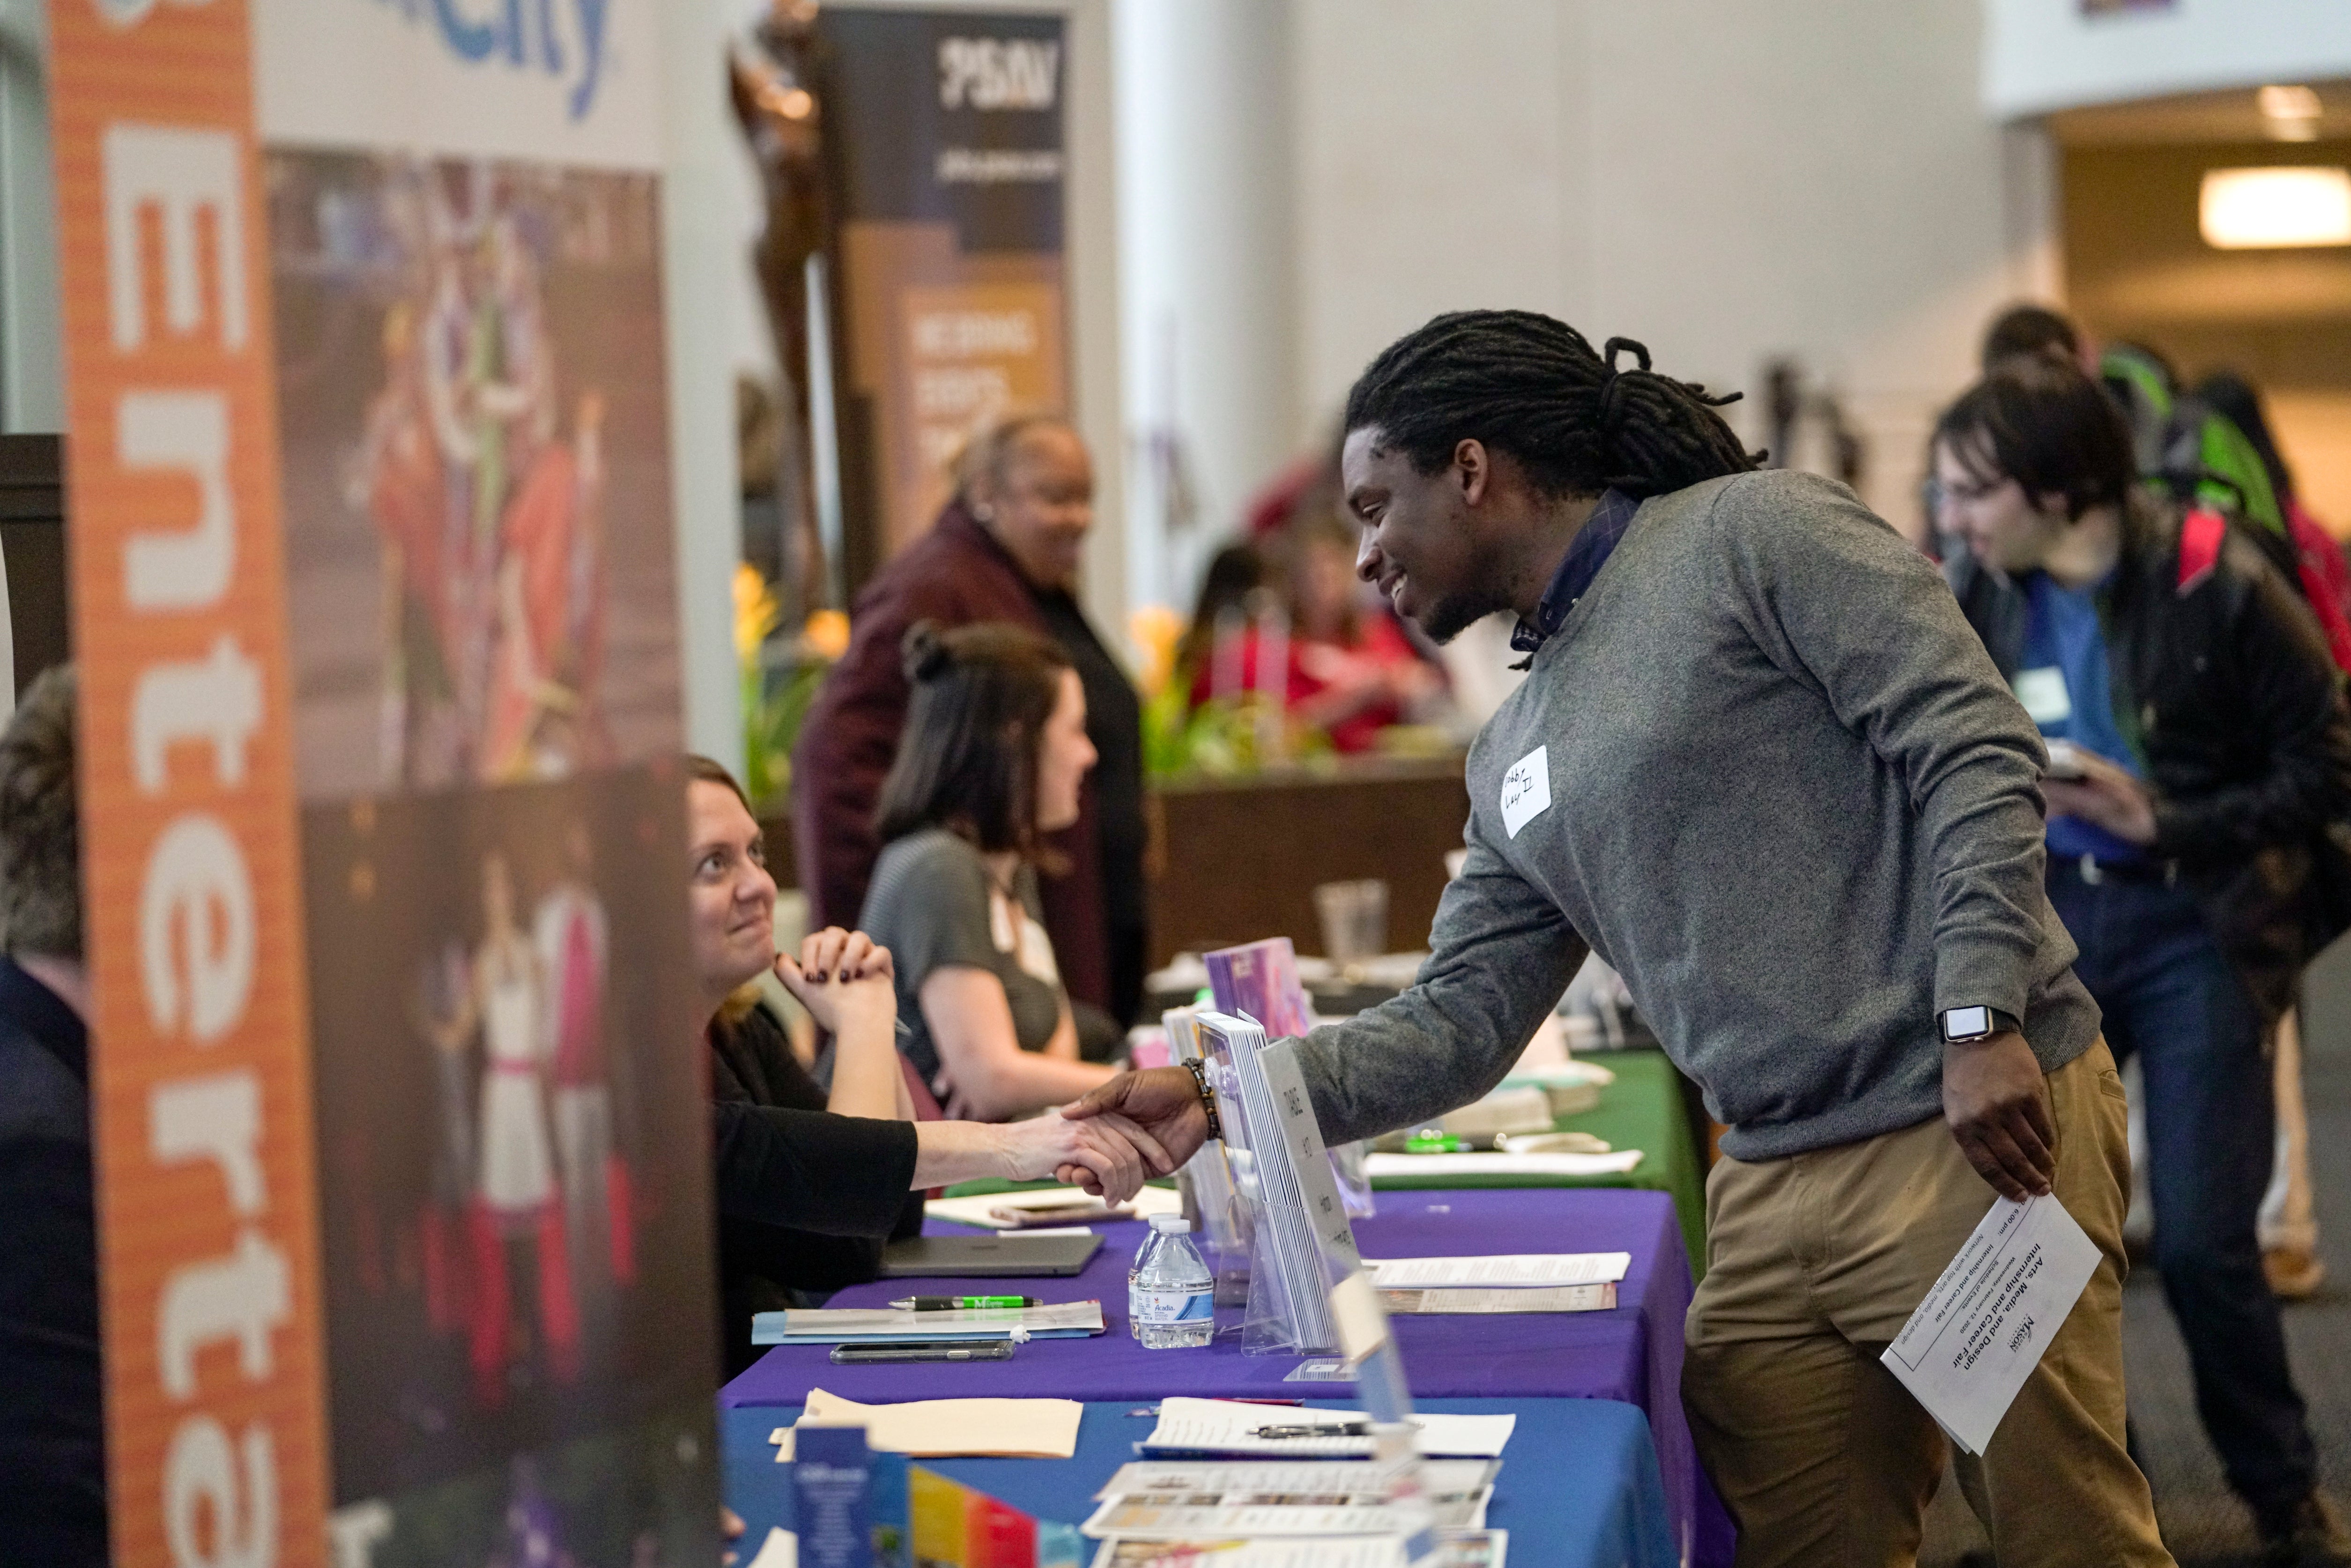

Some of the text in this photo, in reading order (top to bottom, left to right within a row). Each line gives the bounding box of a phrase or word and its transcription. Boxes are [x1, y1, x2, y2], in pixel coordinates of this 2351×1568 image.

[2007, 1209, 2019, 1224] 6:00
[1998, 1222, 2008, 1236] pm:
[1964, 1234, 1984, 1258] Network
[1954, 1258, 1965, 1271] with
[1980, 1260, 1999, 1285] Schedule
[1992, 1257, 2016, 1287] Wednesday,
[1935, 1244, 1994, 1323] Internship and Career Fair
[1947, 1271, 1956, 1281] top
[1936, 1281, 1947, 1294] arts,
[1923, 1294, 1938, 1313] media,
[1953, 1243, 2041, 1368] Internship and Career Fair
[1961, 1291, 1977, 1310] Events:
[1976, 1287, 1994, 1312] February
[1914, 1314, 1924, 1327] and
[1964, 1256, 2043, 1370] Arts, Media, and Design
[1901, 1325, 1915, 1345] design
[1960, 1320, 1971, 1334] 2020
[2010, 1316, 2034, 1351] MASON
[2013, 1332, 2028, 1353] GEORGE
